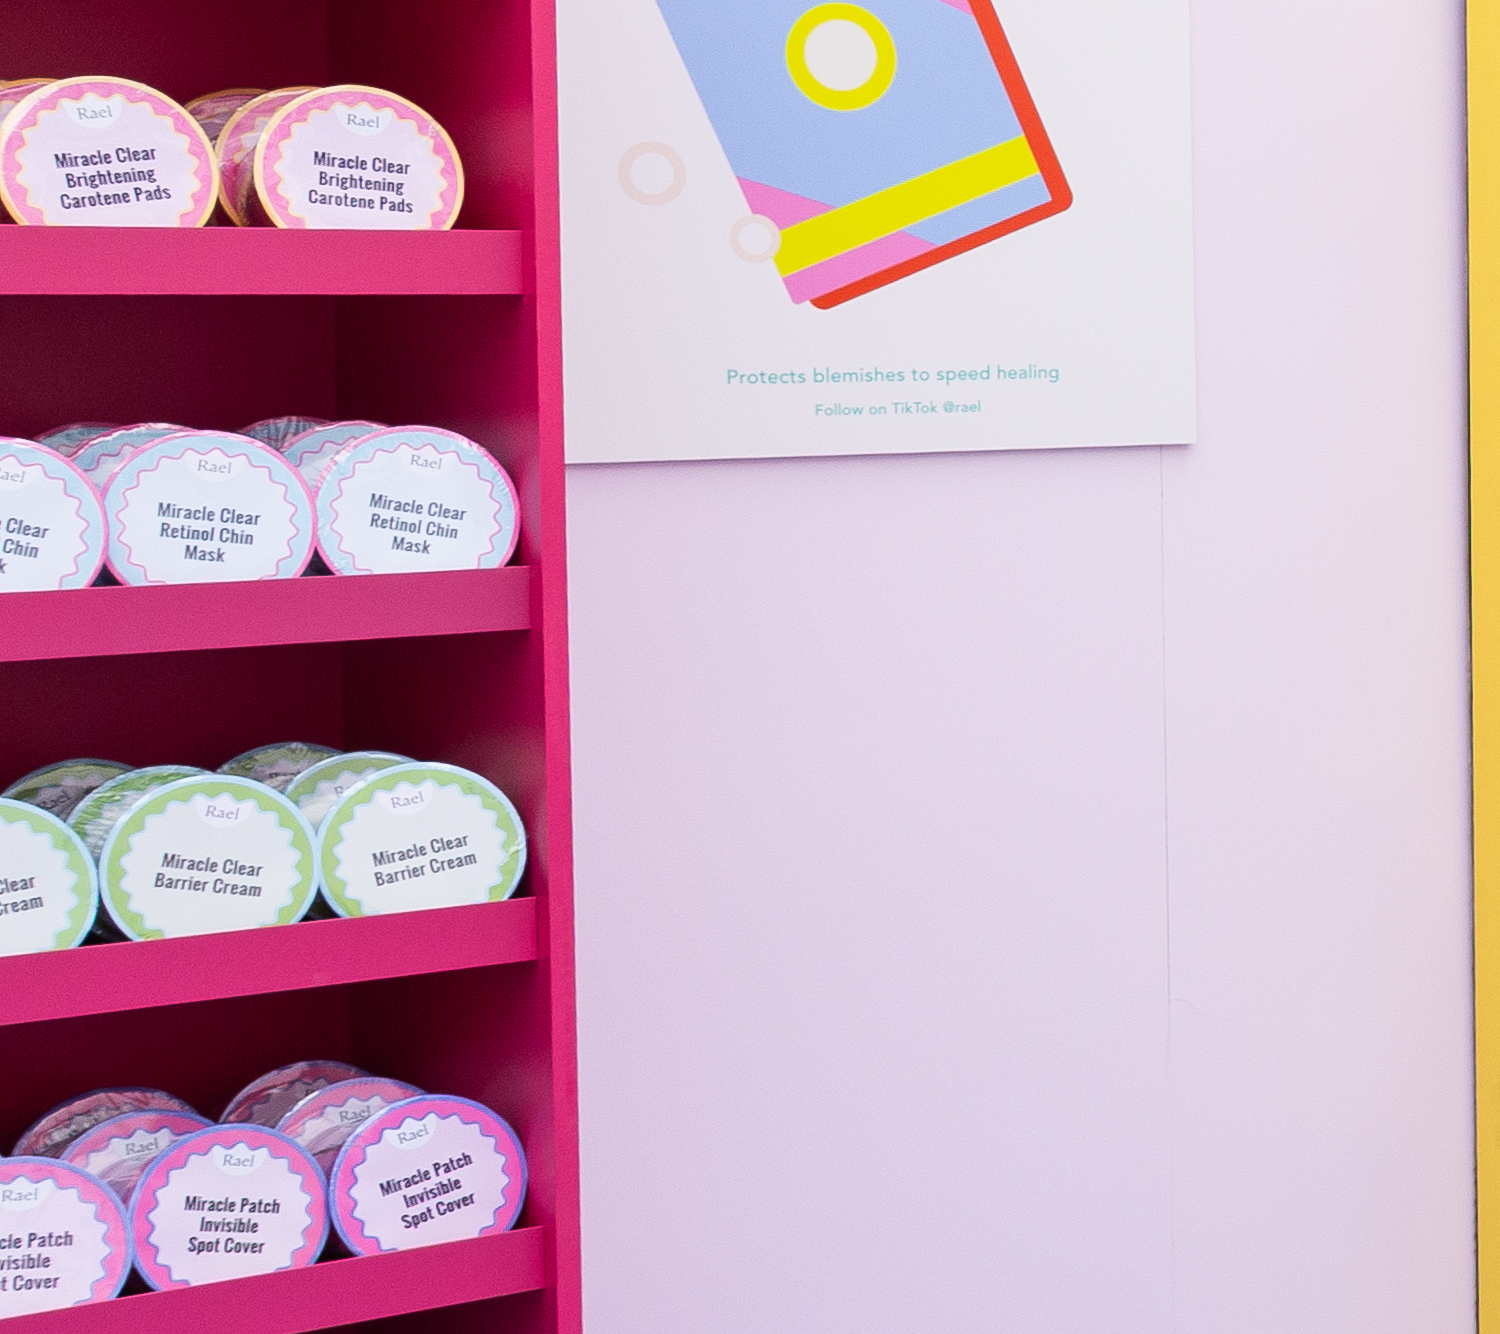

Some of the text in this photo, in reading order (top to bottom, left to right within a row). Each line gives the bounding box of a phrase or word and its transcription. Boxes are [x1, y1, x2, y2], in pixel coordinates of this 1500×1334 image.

[346, 112, 381, 129] Rael
[313, 150, 411, 176] Miracle Clear
[318, 171, 405, 195] Brightening
[308, 189, 414, 214] Carotene Pads
[727, 363, 1060, 386] Protects blemishes to speed healing
[815, 400, 981, 416] Follow on TikTok @rael
[197, 458, 232, 475] Rael
[157, 502, 261, 526] Miracle Clear
[159, 522, 254, 546] Retinol Chin
[184, 545, 226, 564] Mask
[390, 790, 424, 810] Rael
[371, 833, 470, 868] Miracle Clear
[374, 851, 477, 887] Barrier Cream
[222, 1153, 256, 1168] Rael
[184, 1195, 280, 1215] Miracle Patch
[200, 1216, 259, 1235] Invisible
[187, 1237, 265, 1256] Spot Cover
